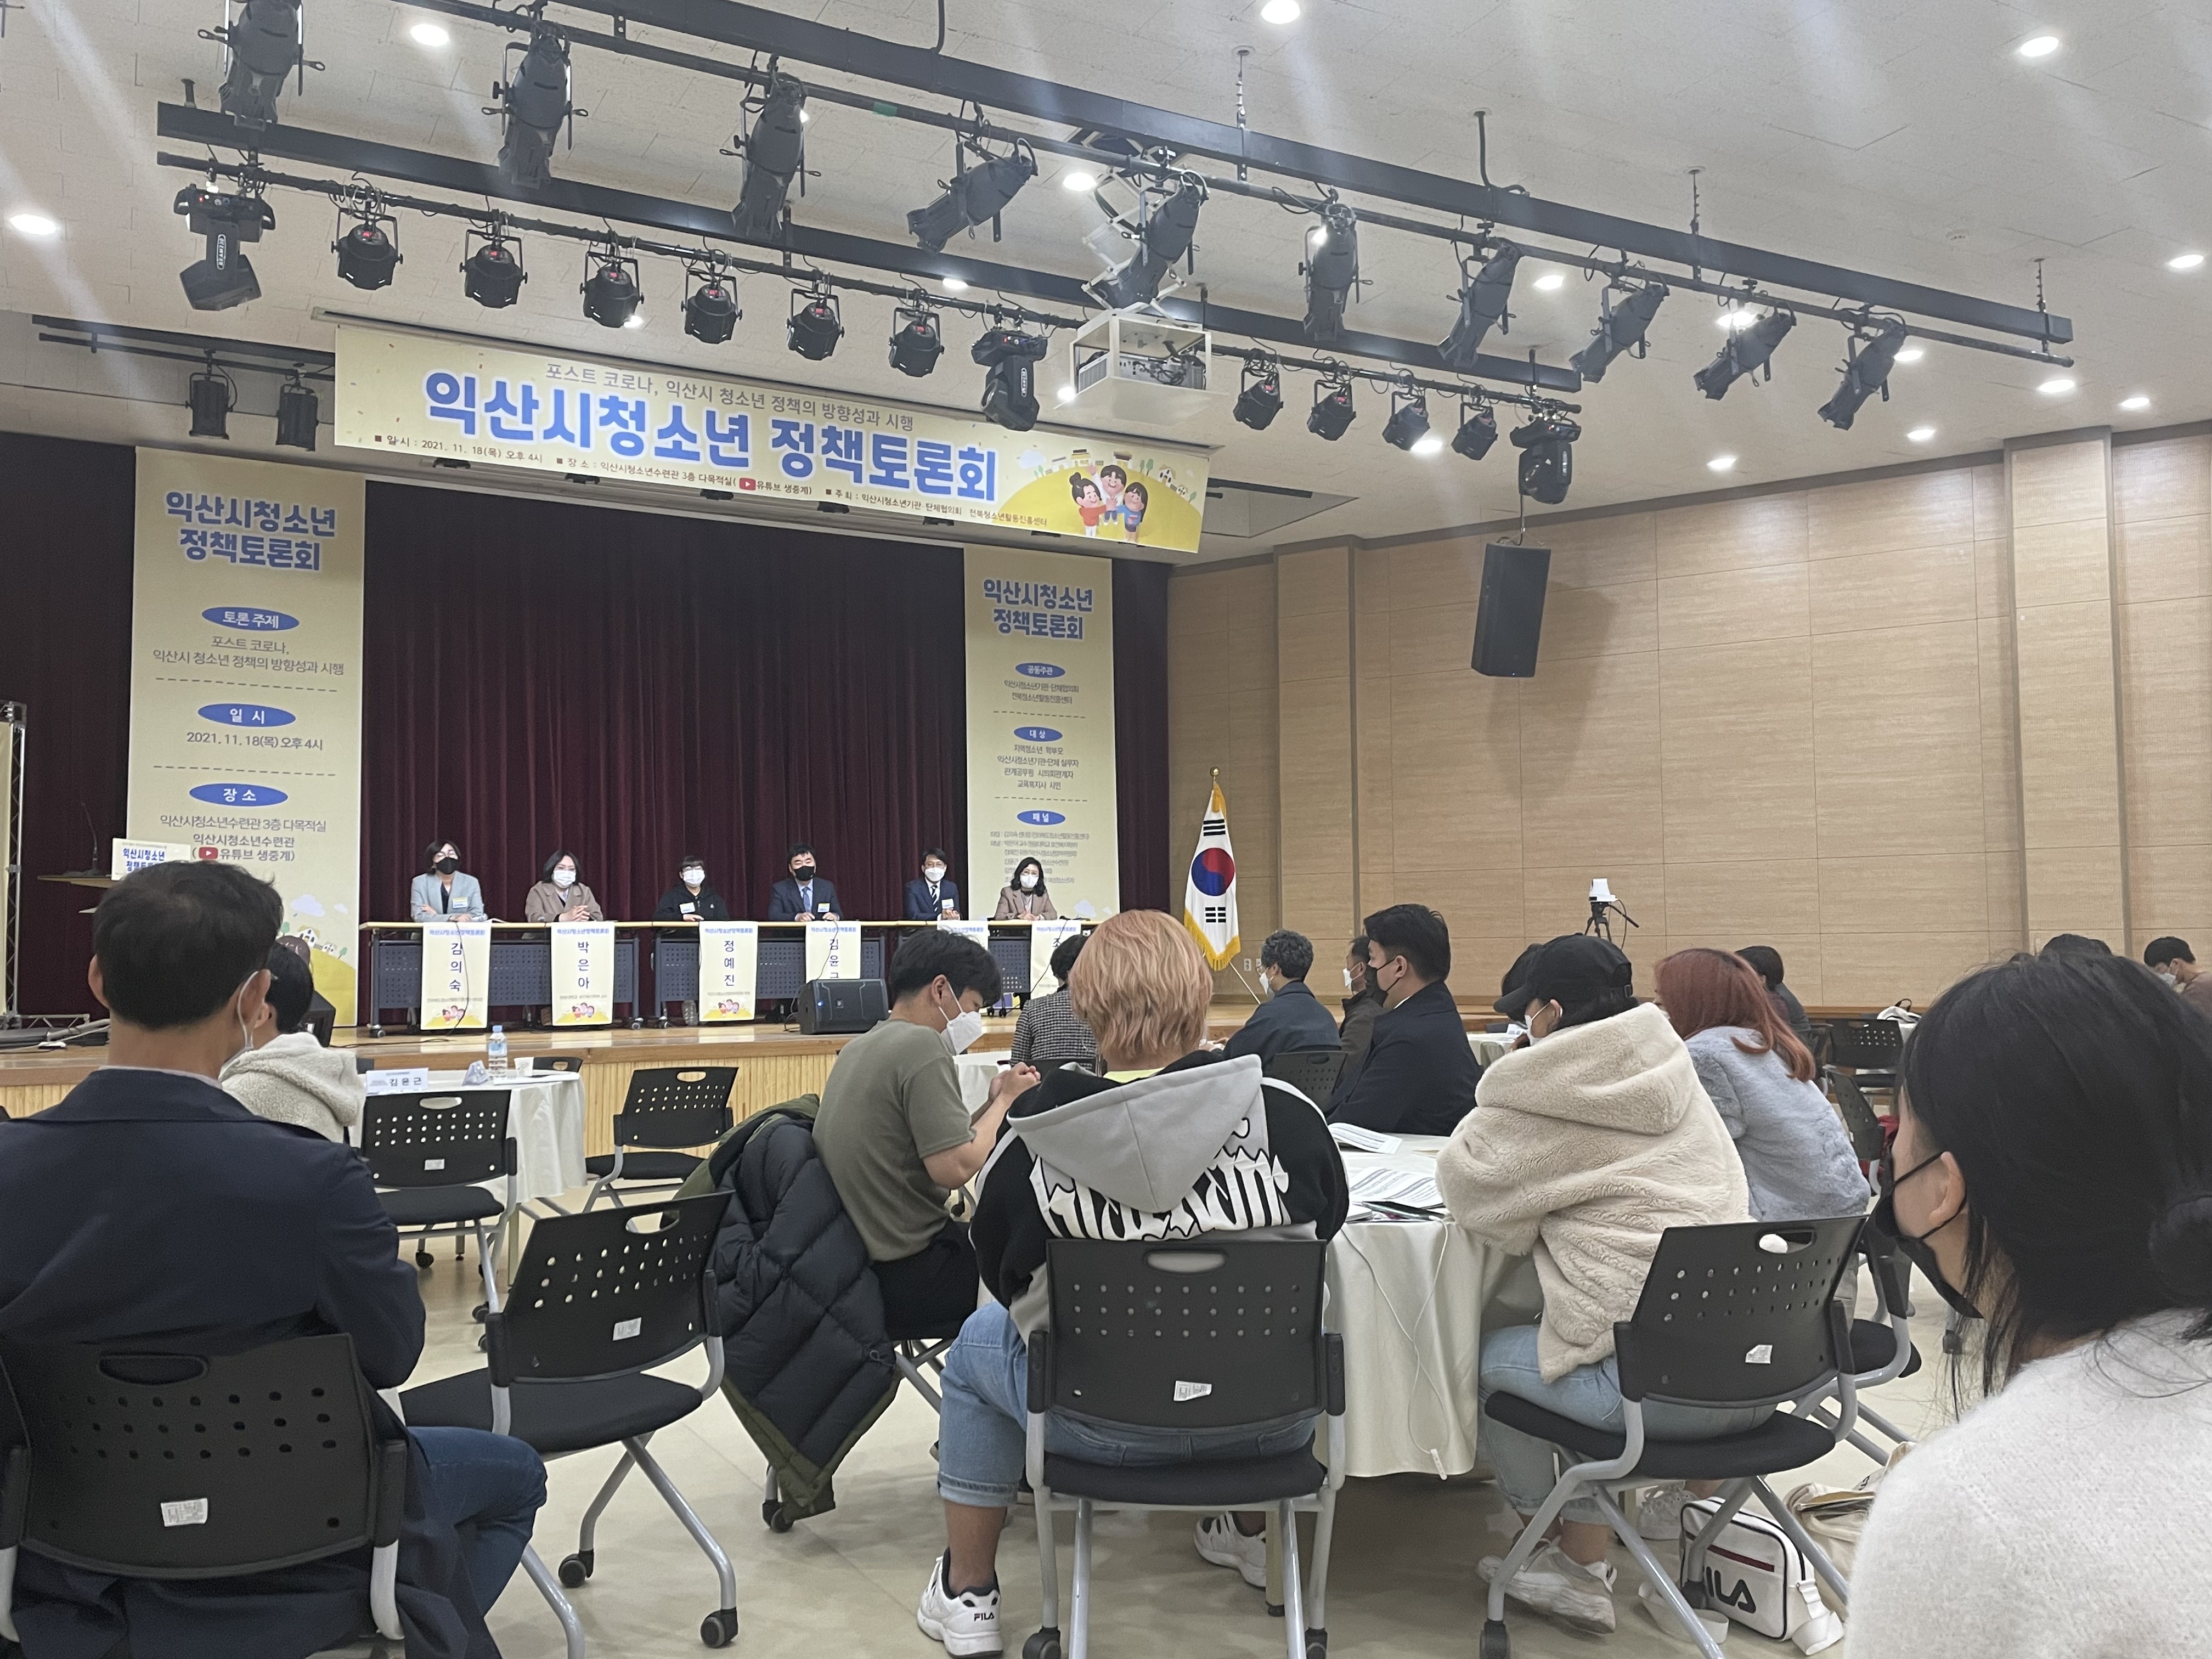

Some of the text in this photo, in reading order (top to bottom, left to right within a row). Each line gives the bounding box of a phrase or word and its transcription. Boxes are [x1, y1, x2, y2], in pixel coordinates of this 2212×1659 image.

[546, 364, 913, 432] 포스트 코로나, 익산시 청소년 정책의 방향성과 시행
[425, 372, 995, 501] 익산시청소년 정책토론회
[422, 441, 448, 451] 2021.
[453, 444, 467, 453] 11.
[473, 447, 501, 458] 18(목)
[506, 451, 524, 460] 오후
[528, 454, 542, 463] 4시
[601, 461, 679, 480] 익산시청소년수련관
[682, 472, 695, 482] 3층
[756, 481, 811, 495] 유튜브 생중계)
[166, 492, 335, 537] 익산시청소년
[969, 509, 1047, 526] 전북청소년활동진흥센터
[180, 528, 319, 571] 정책토론회
[983, 579, 1092, 612] 익산시청소년
[223, 611, 279, 629] 토론 주제
[994, 608, 1083, 640] 정책토론회
[211, 636, 289, 655] 포스트 코로나,
[153, 650, 344, 675] 익산시 청소년 정책의 방향성과 시행
[187, 732, 323, 751] 2021. 11. 18(목) 오후 4시
[1049, 781, 1061, 790] 시민
[160, 815, 326, 832] 익산시청소년수련관 3층 다목적실
[193, 833, 295, 848] 익산시청소년수련관
[123, 848, 165, 861] 익산시청소년
[220, 849, 253, 860] 유튜브
[257, 849, 295, 862] 생중계)
[578, 941, 590, 989] 박은아
[724, 940, 735, 986] 정예진
[1706, 1566, 1756, 1614] ILA
[974, 1612, 994, 1621] FILA
